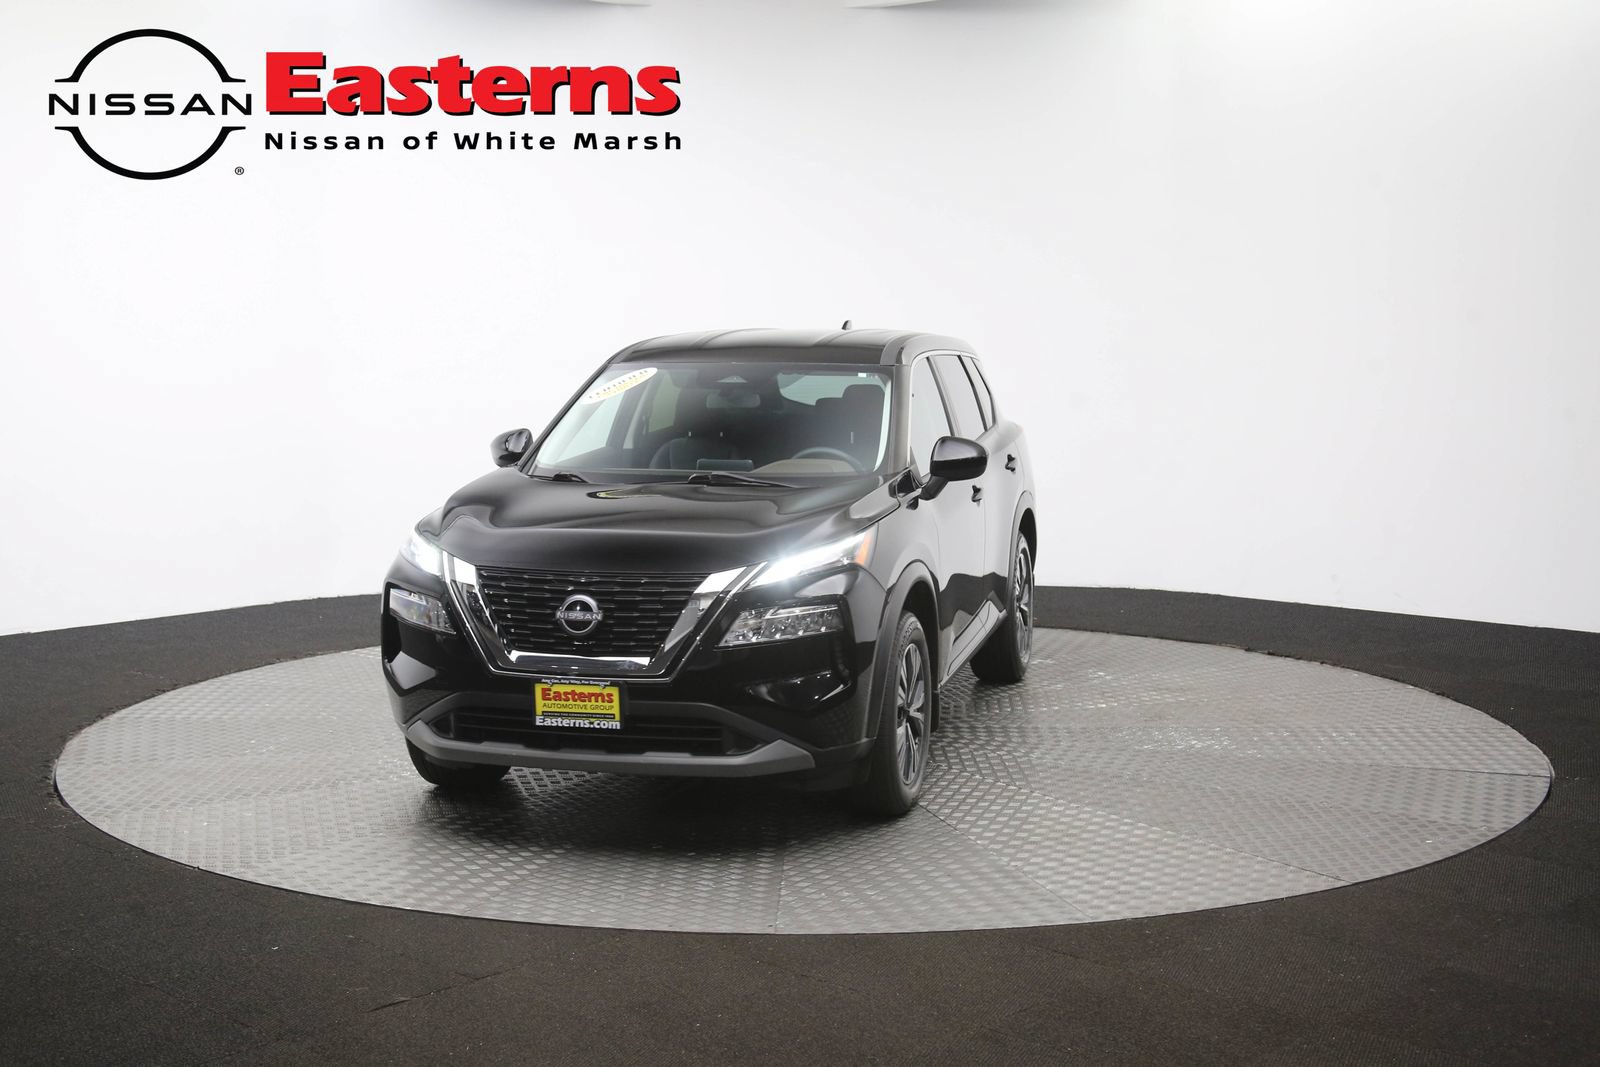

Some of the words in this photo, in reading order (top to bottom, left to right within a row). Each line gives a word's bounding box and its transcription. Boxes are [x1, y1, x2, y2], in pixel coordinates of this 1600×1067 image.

[556, 611, 602, 620] NISSAN
[541, 687, 614, 704] Easterns
[542, 702, 588, 711] AUTOMOTIVE
[535, 715, 621, 730] Easterns.com
